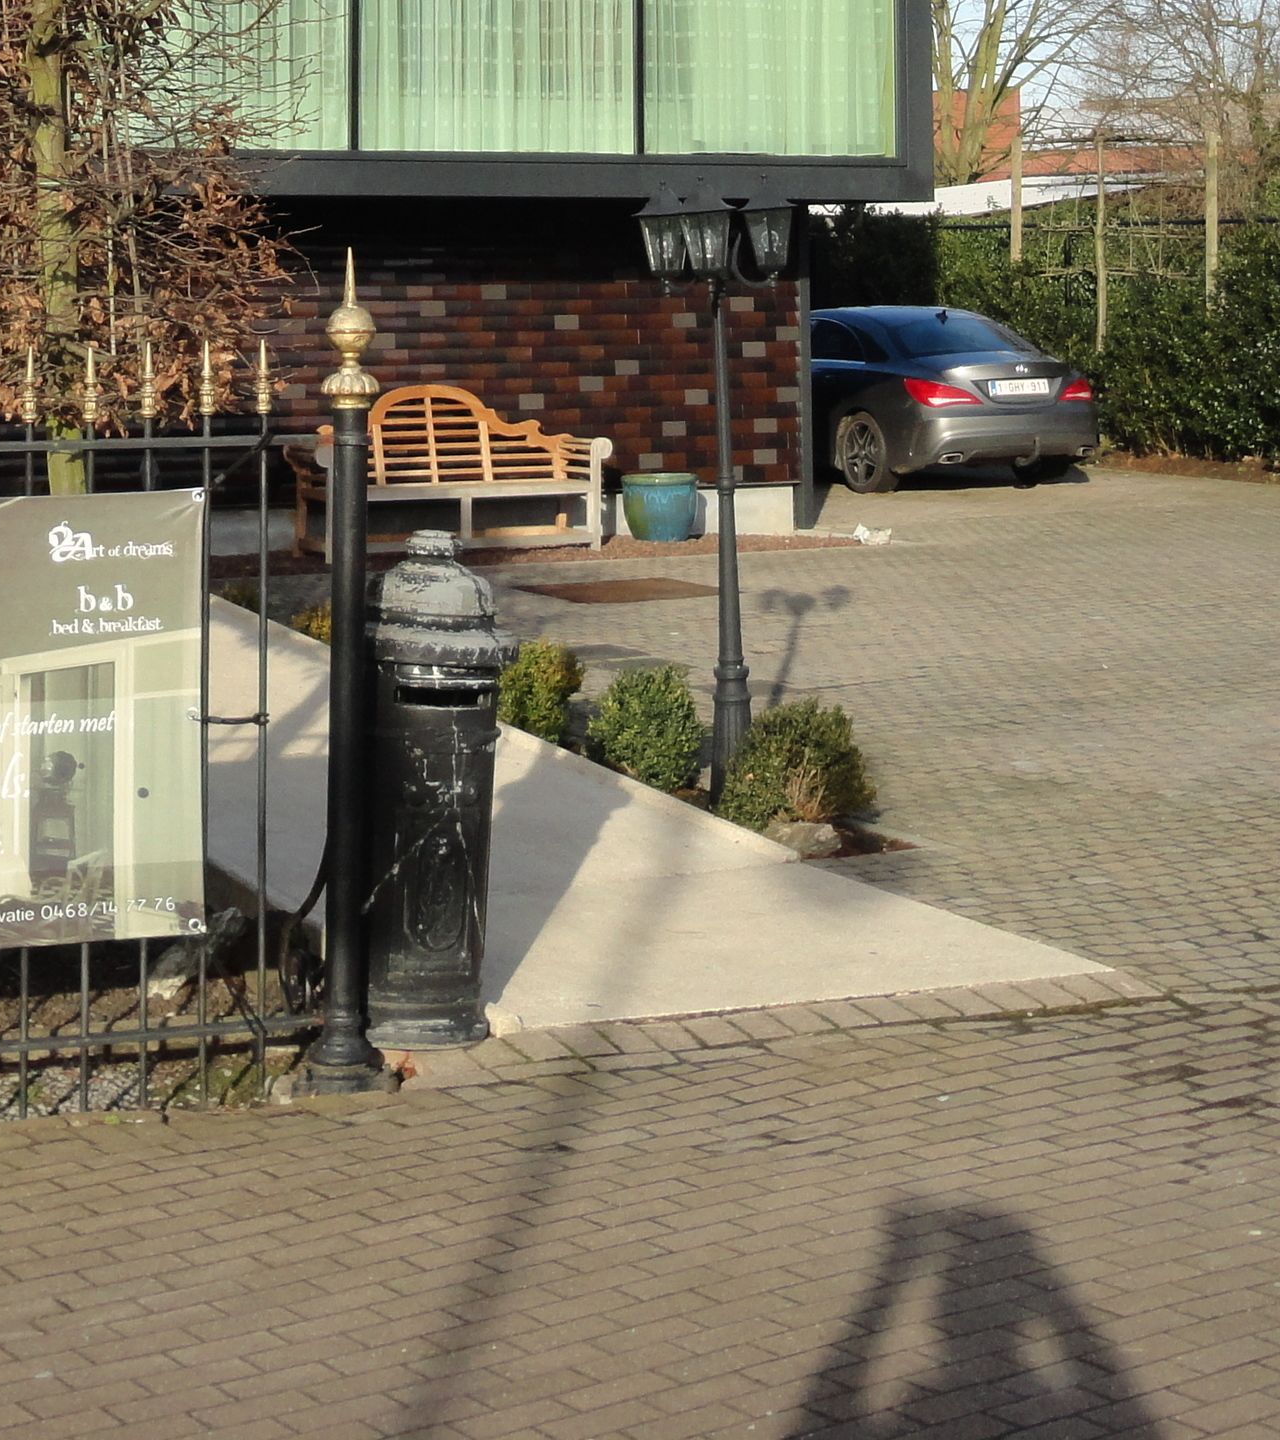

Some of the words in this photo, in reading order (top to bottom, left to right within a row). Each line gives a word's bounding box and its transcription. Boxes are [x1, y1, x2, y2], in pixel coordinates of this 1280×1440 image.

[108, 546, 121, 557] of
[123, 540, 176, 559] dreams
[49, 619, 79, 636] bed
[81, 618, 95, 634] &
[96, 616, 164, 634] breakfast
[14, 712, 74, 736] starten
[79, 710, 116, 732] met
[40, 901, 118, 921] 0468/14
[126, 898, 147, 913] 77
[154, 896, 176, 912] 76
